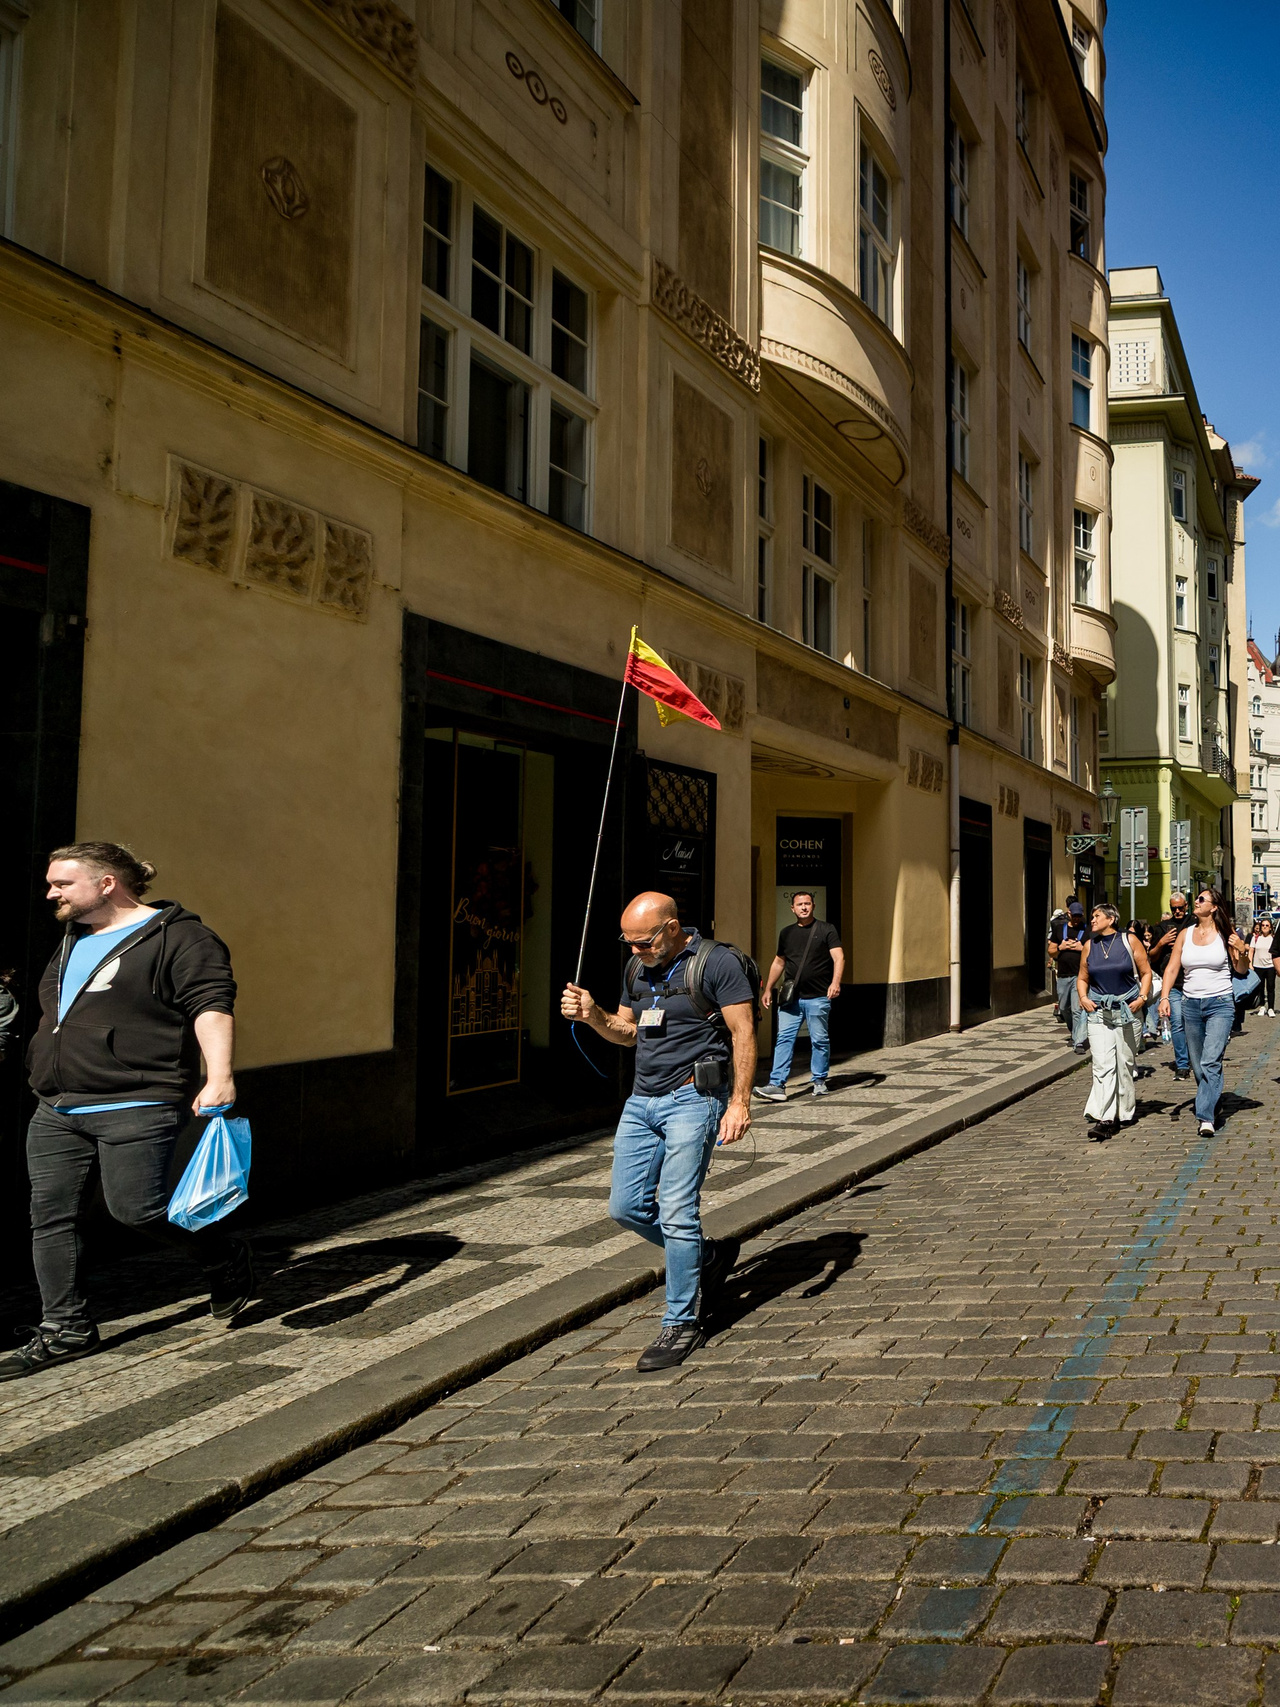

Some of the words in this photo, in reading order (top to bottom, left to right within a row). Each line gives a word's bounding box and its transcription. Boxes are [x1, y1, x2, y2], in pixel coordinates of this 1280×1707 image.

[779, 839, 823, 850] COHEN
[454, 897, 486, 929] Buon
[483, 925, 520, 950] giorno
